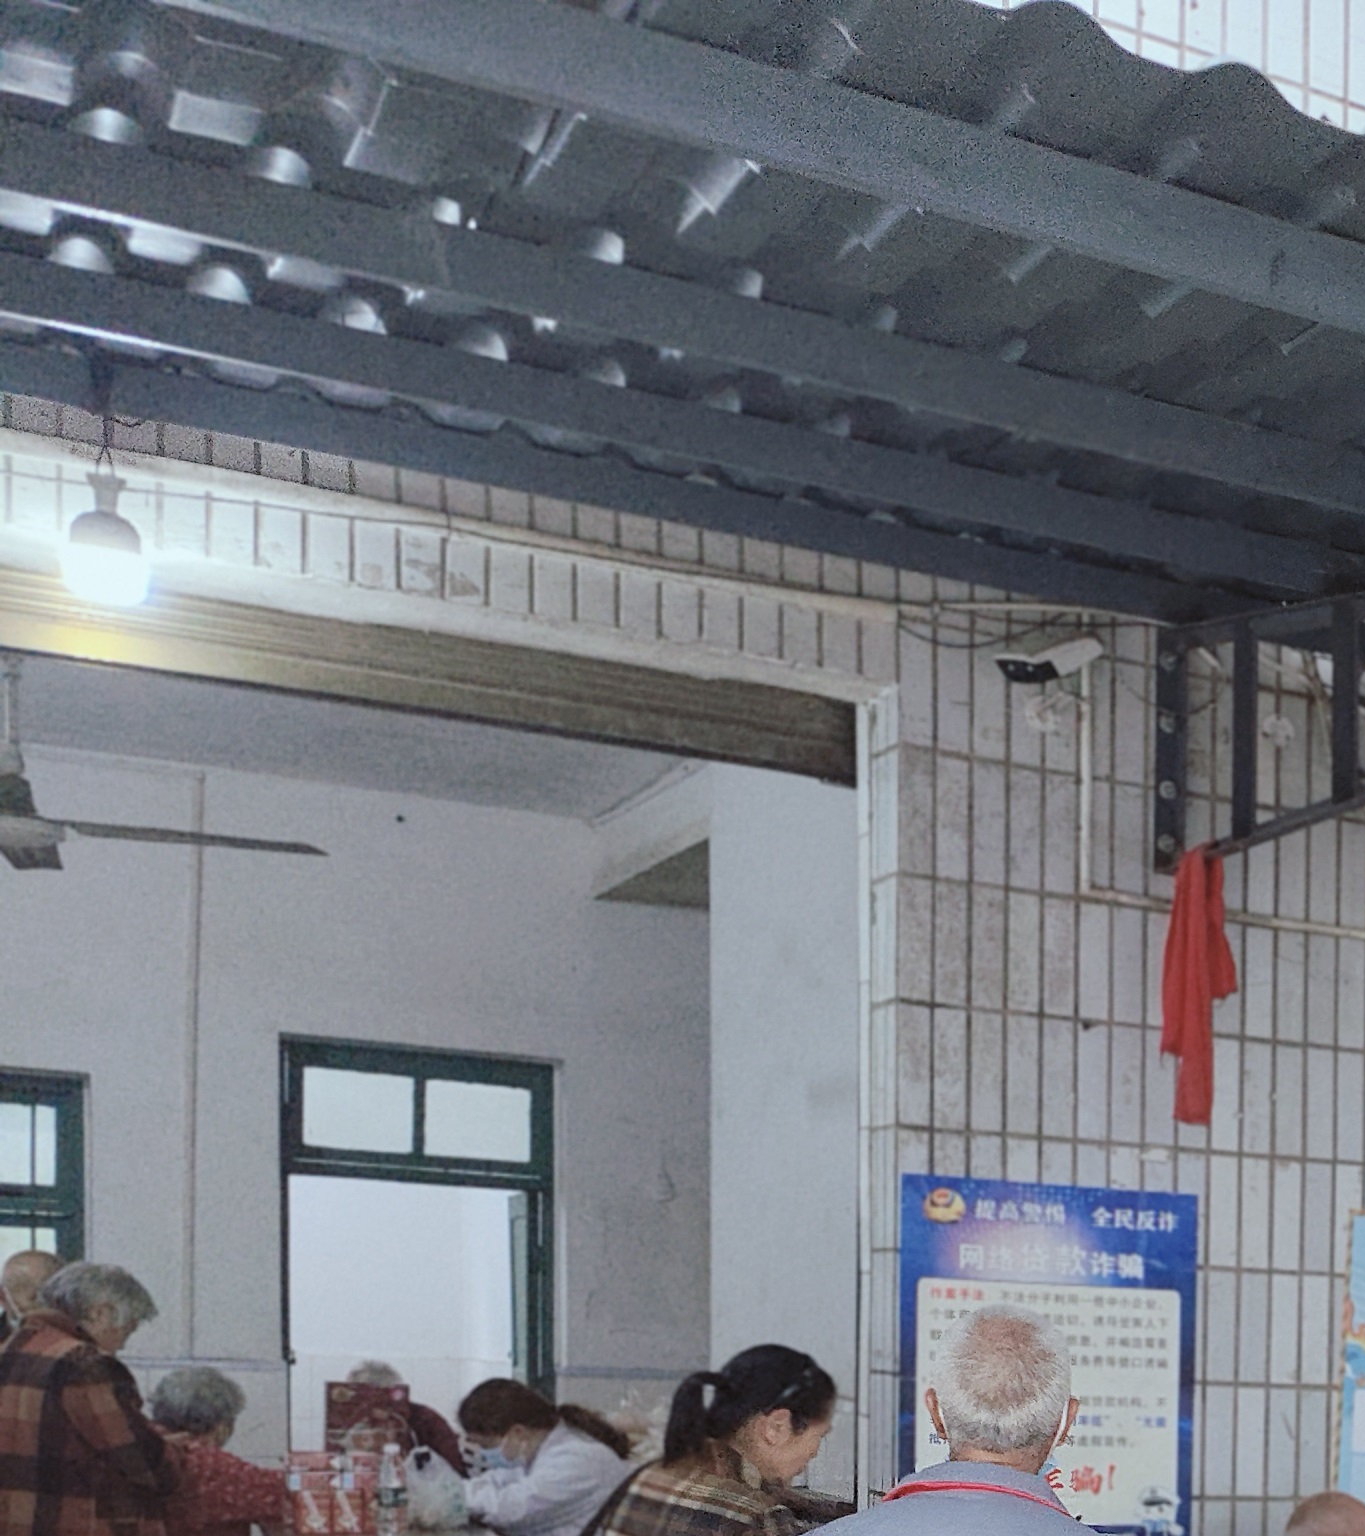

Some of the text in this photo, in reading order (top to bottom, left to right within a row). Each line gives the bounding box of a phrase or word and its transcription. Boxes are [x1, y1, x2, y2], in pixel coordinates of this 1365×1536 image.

[1091, 1207, 1179, 1234] 全民反诈
[958, 1243, 1146, 1281] 网络贷款诈骗
